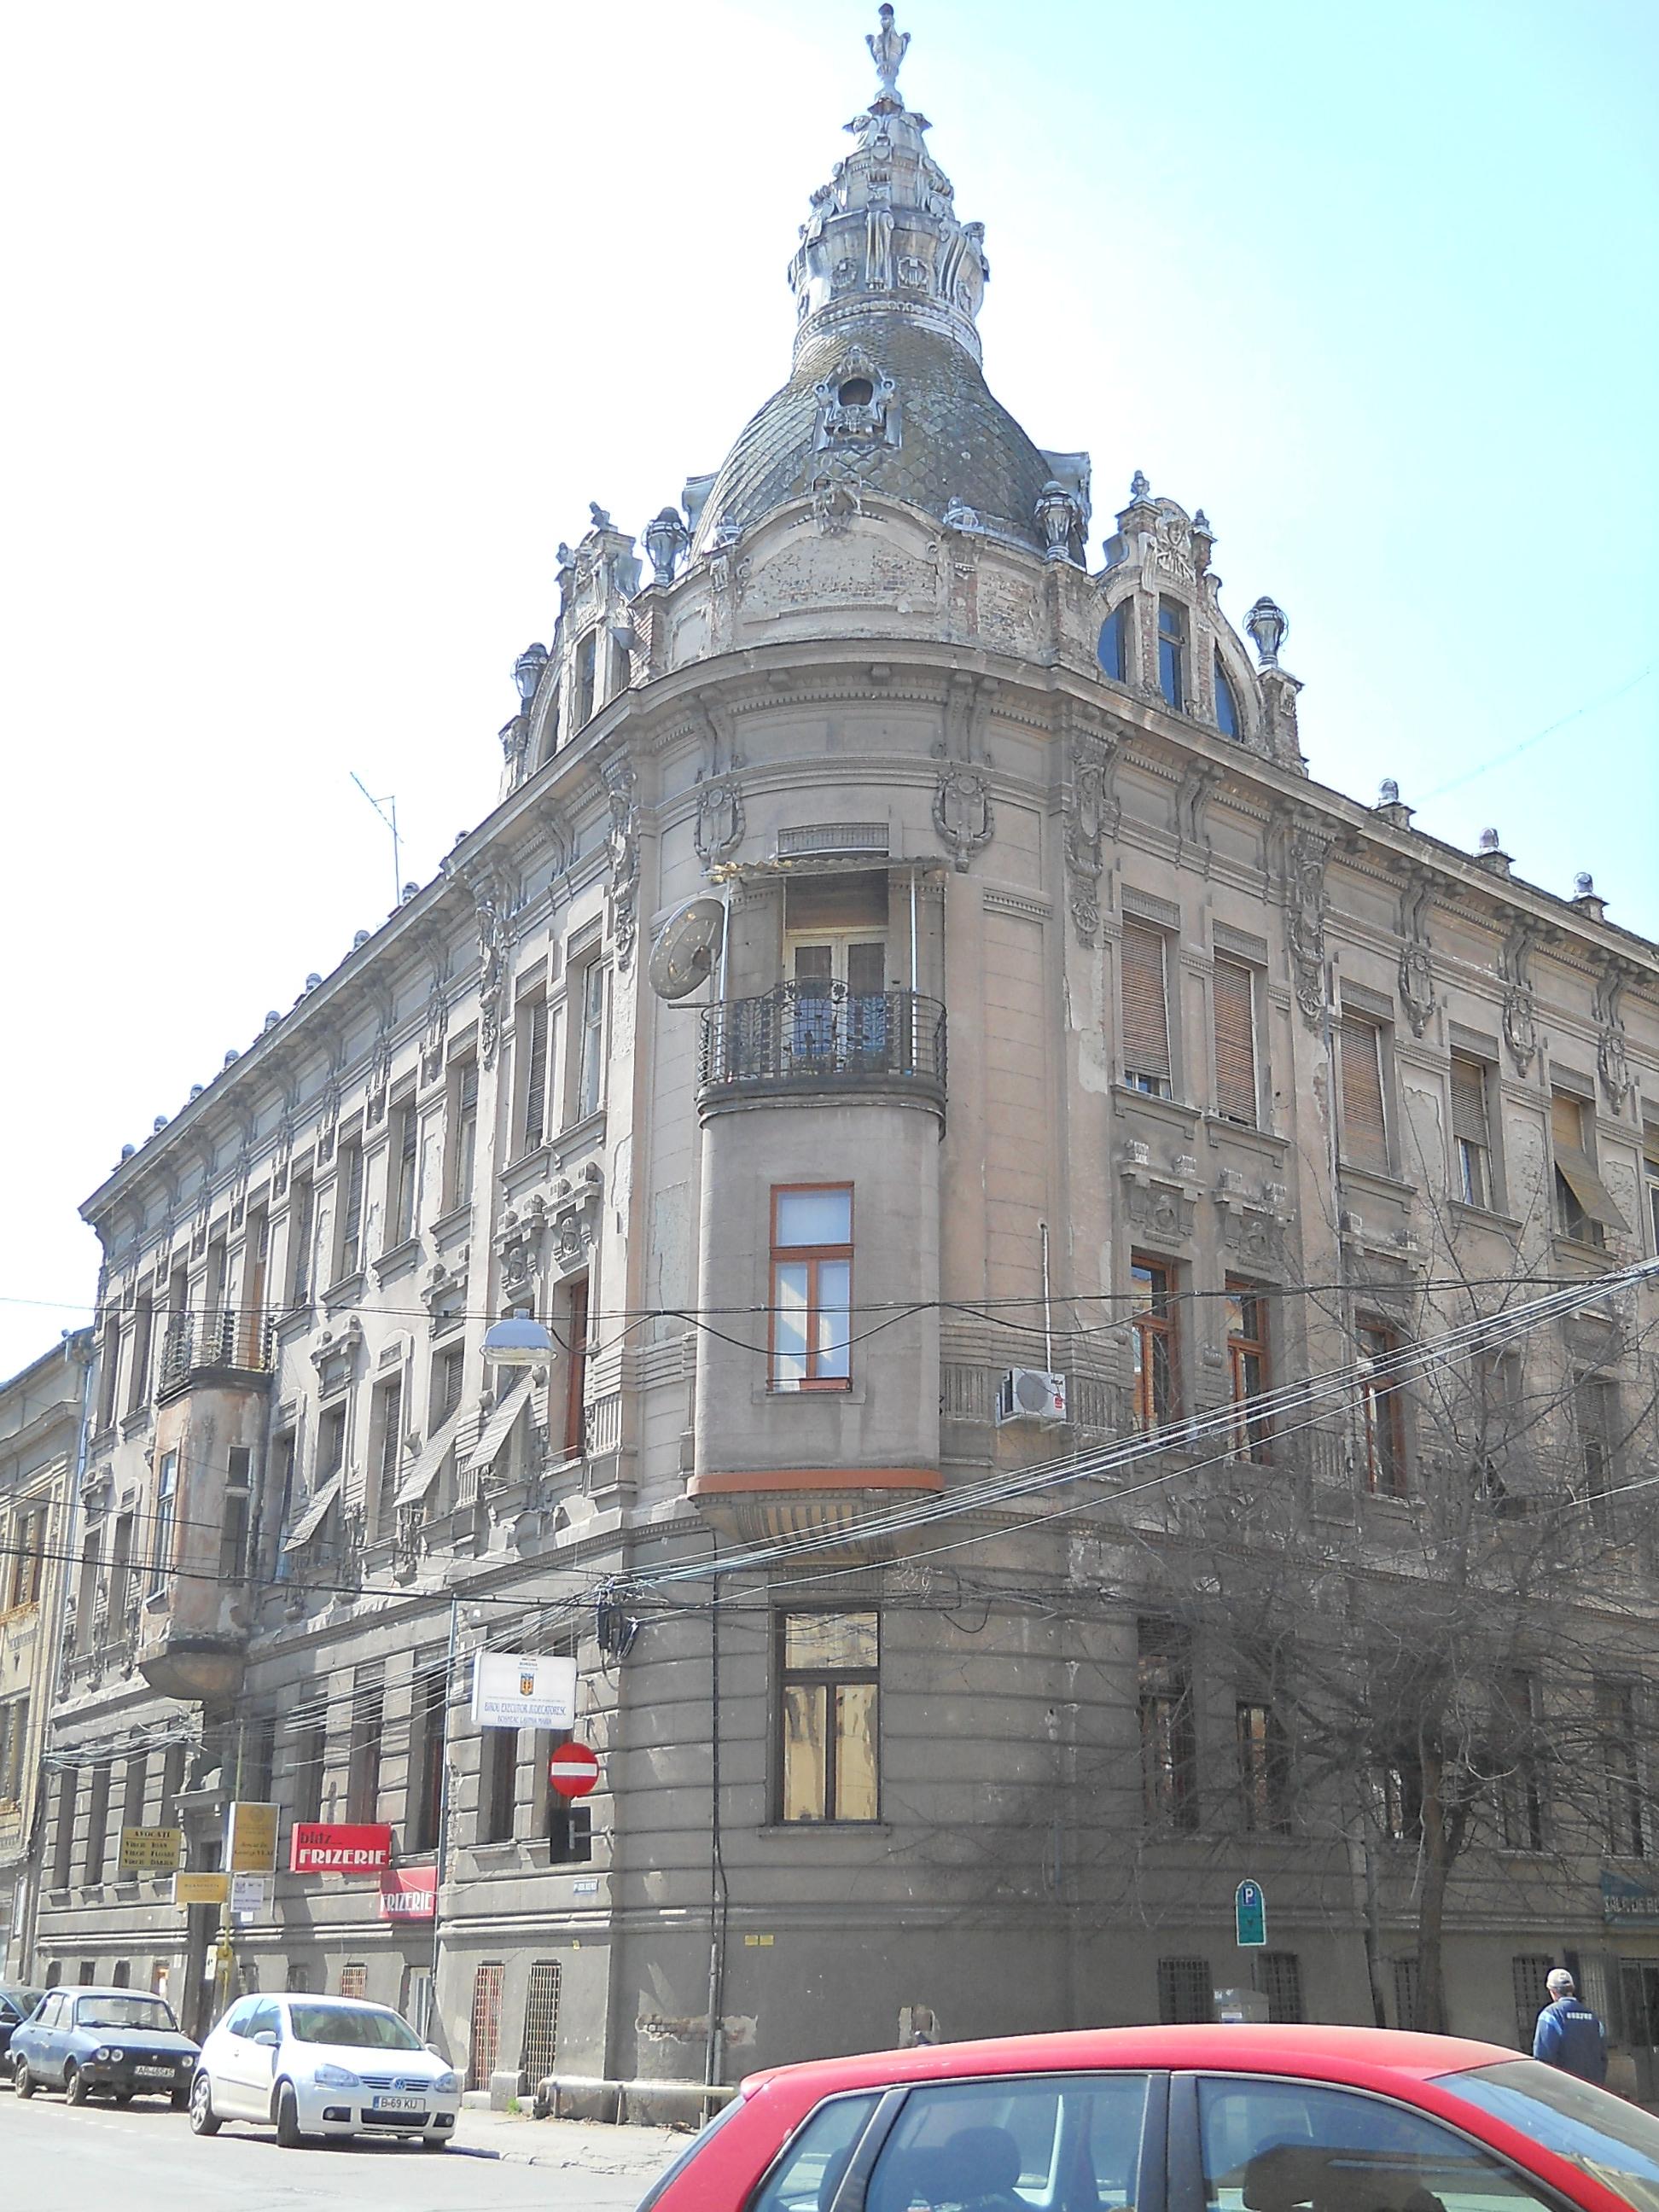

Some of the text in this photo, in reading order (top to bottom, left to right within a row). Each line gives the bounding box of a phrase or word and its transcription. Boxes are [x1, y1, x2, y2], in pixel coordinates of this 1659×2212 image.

[299, 1848, 387, 1866] FRIZERIE
[380, 1891, 434, 1912] FRIZERIE
[1245, 1888, 1254, 1903] P
